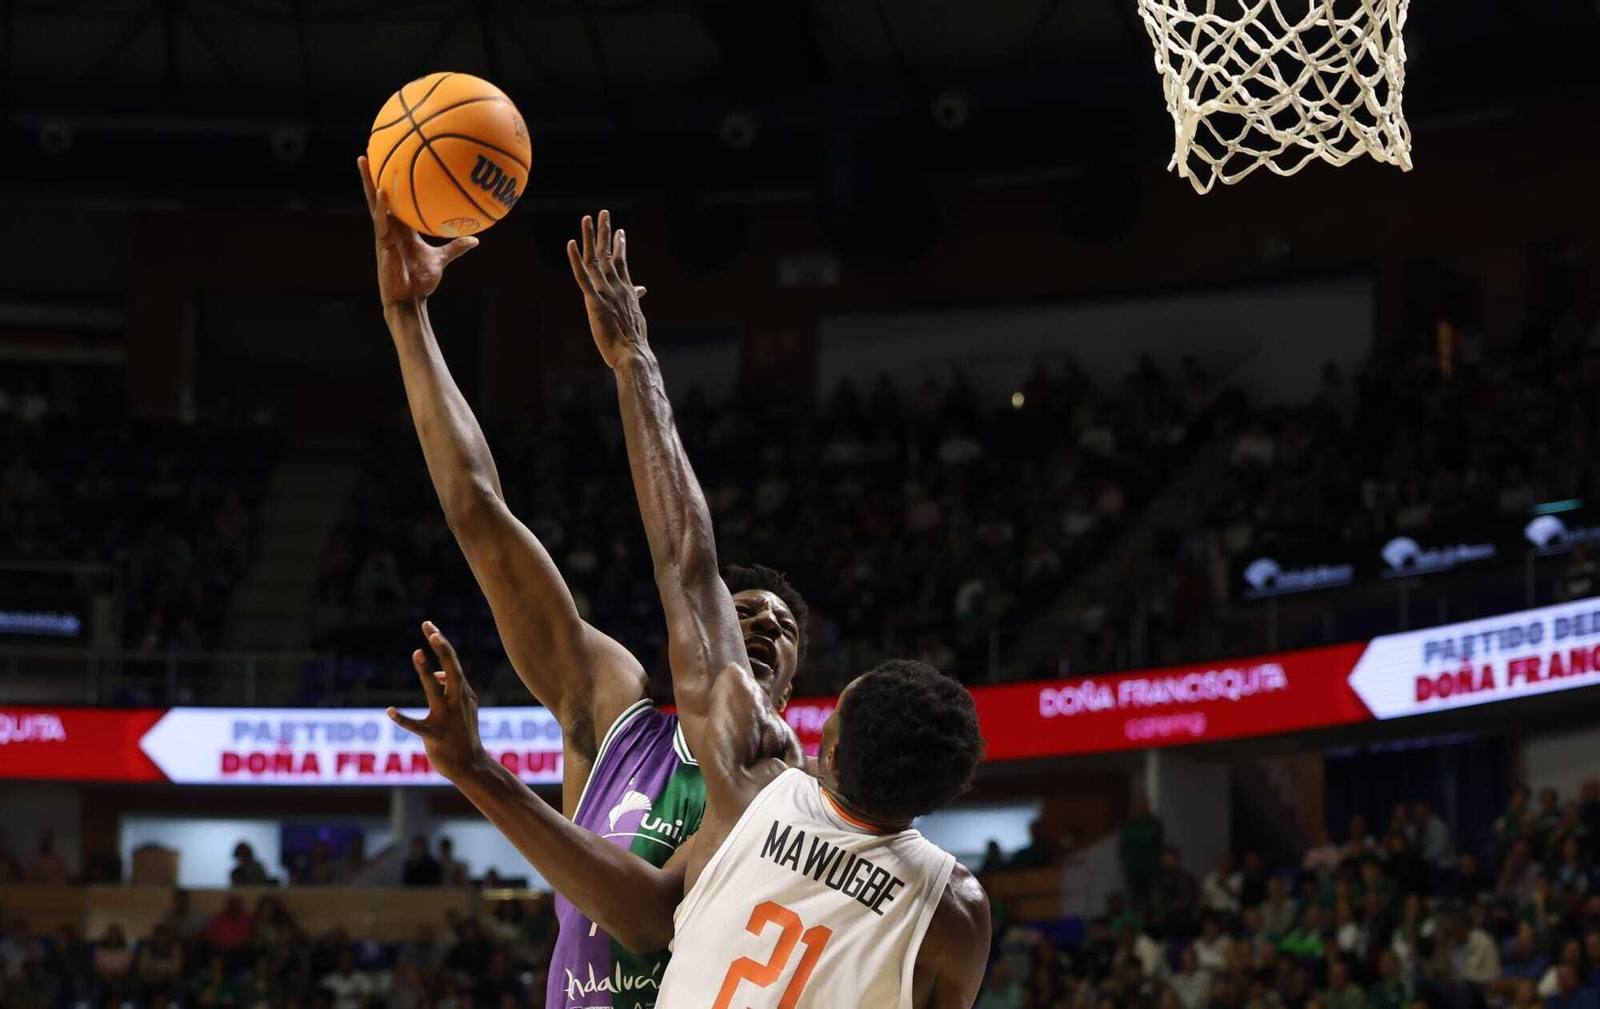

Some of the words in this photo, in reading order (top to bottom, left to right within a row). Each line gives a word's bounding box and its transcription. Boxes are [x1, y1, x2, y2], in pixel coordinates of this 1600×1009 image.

[221, 741, 320, 775] DOÑA
[760, 820, 905, 916] MAWUGBE
[711, 900, 833, 1009] 21
